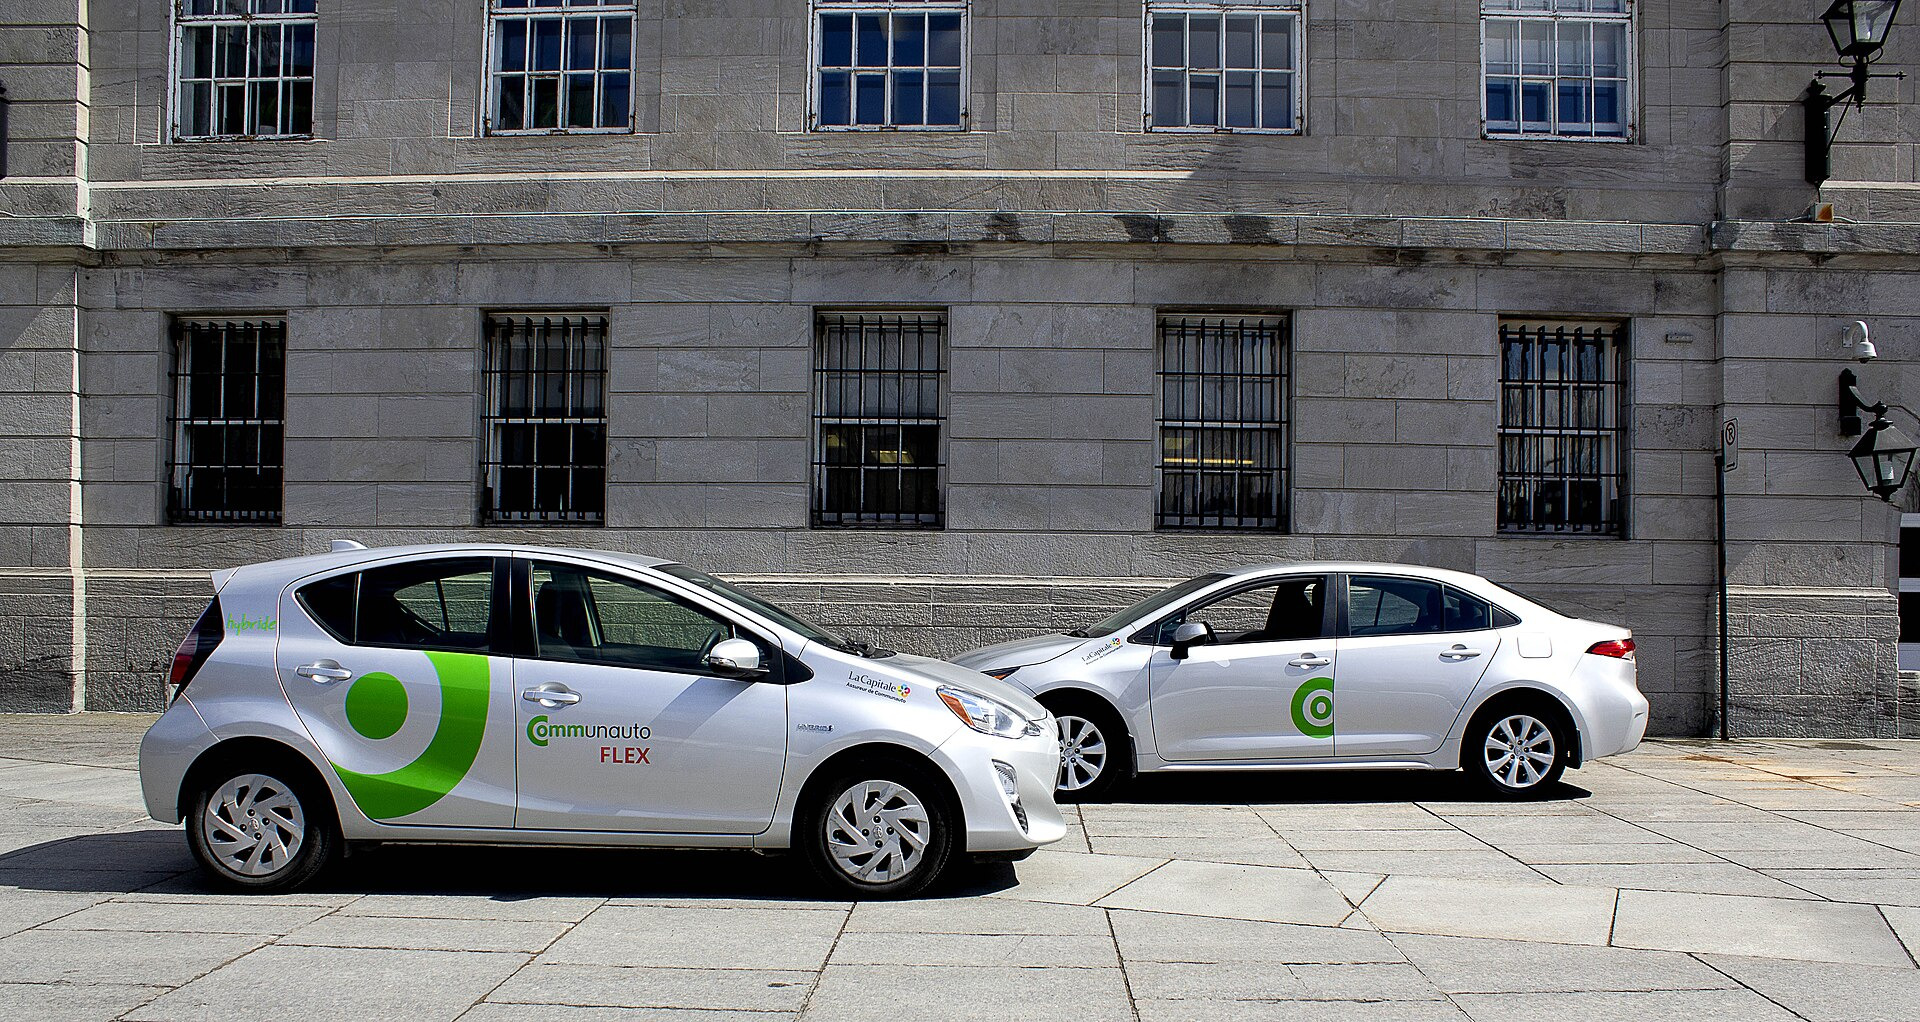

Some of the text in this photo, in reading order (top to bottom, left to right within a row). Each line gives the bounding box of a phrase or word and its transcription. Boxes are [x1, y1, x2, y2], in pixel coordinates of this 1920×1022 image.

[226, 612, 277, 636] hybride
[846, 682, 868, 692] Assureur
[874, 690, 907, 704] Communauto
[526, 714, 651, 747] Communauto
[600, 746, 651, 764] FLEX
